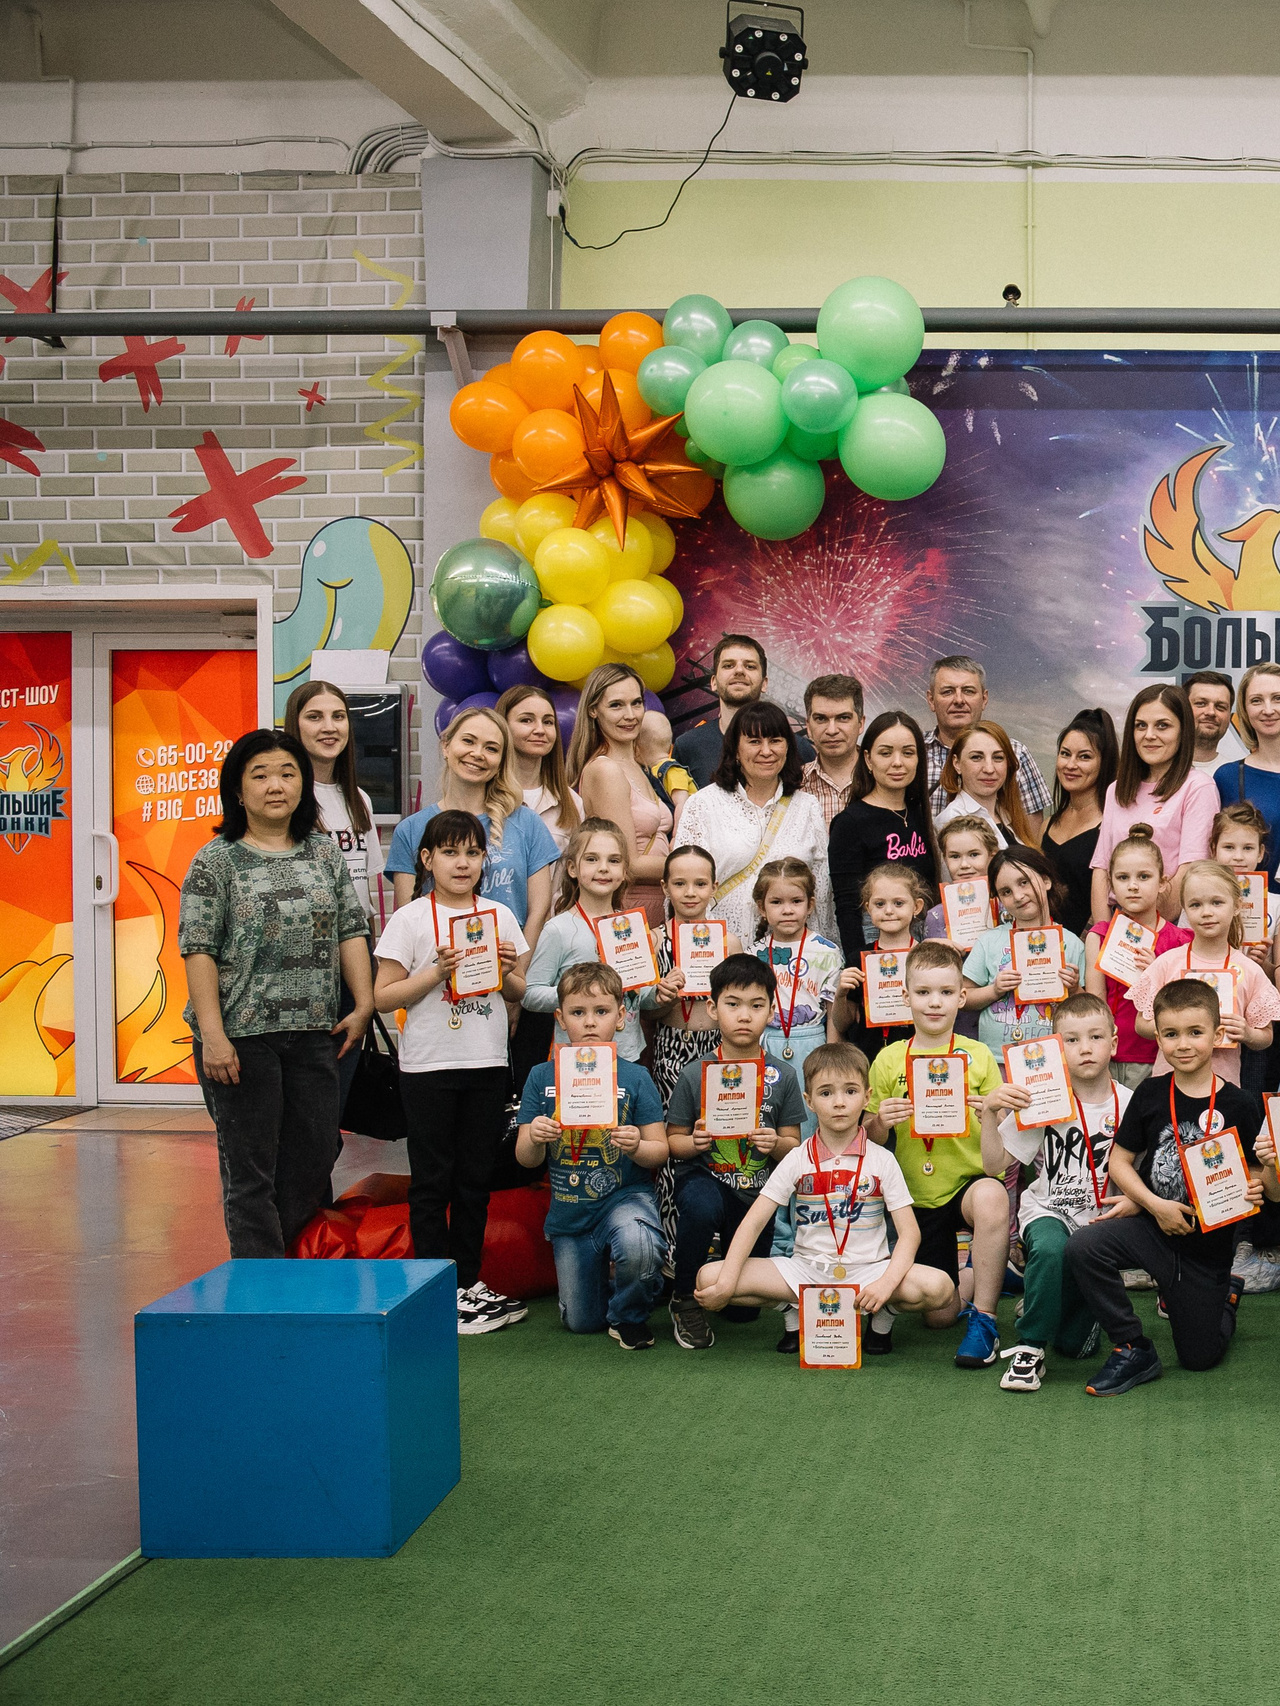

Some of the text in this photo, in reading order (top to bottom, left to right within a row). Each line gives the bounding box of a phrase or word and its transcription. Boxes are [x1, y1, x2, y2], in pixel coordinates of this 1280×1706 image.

[886, 831, 927, 860] Barbie
[691, 950, 715, 960] ДИПЛОМ
[1026, 957, 1052, 968] ДИПЛОМ
[878, 980, 904, 990] ДИПЛОМ
[573, 1078, 602, 1088] ДИПЛОМ
[1025, 1072, 1054, 1086] ДИПЛОМ
[718, 1093, 745, 1102] ДИПЛОМ
[926, 1089, 954, 1098] ДИПЛОМ
[587, 1159, 599, 1168] up
[1206, 1167, 1233, 1186] ДИПЛОМ
[817, 1319, 845, 1328] ДИПЛОМ
